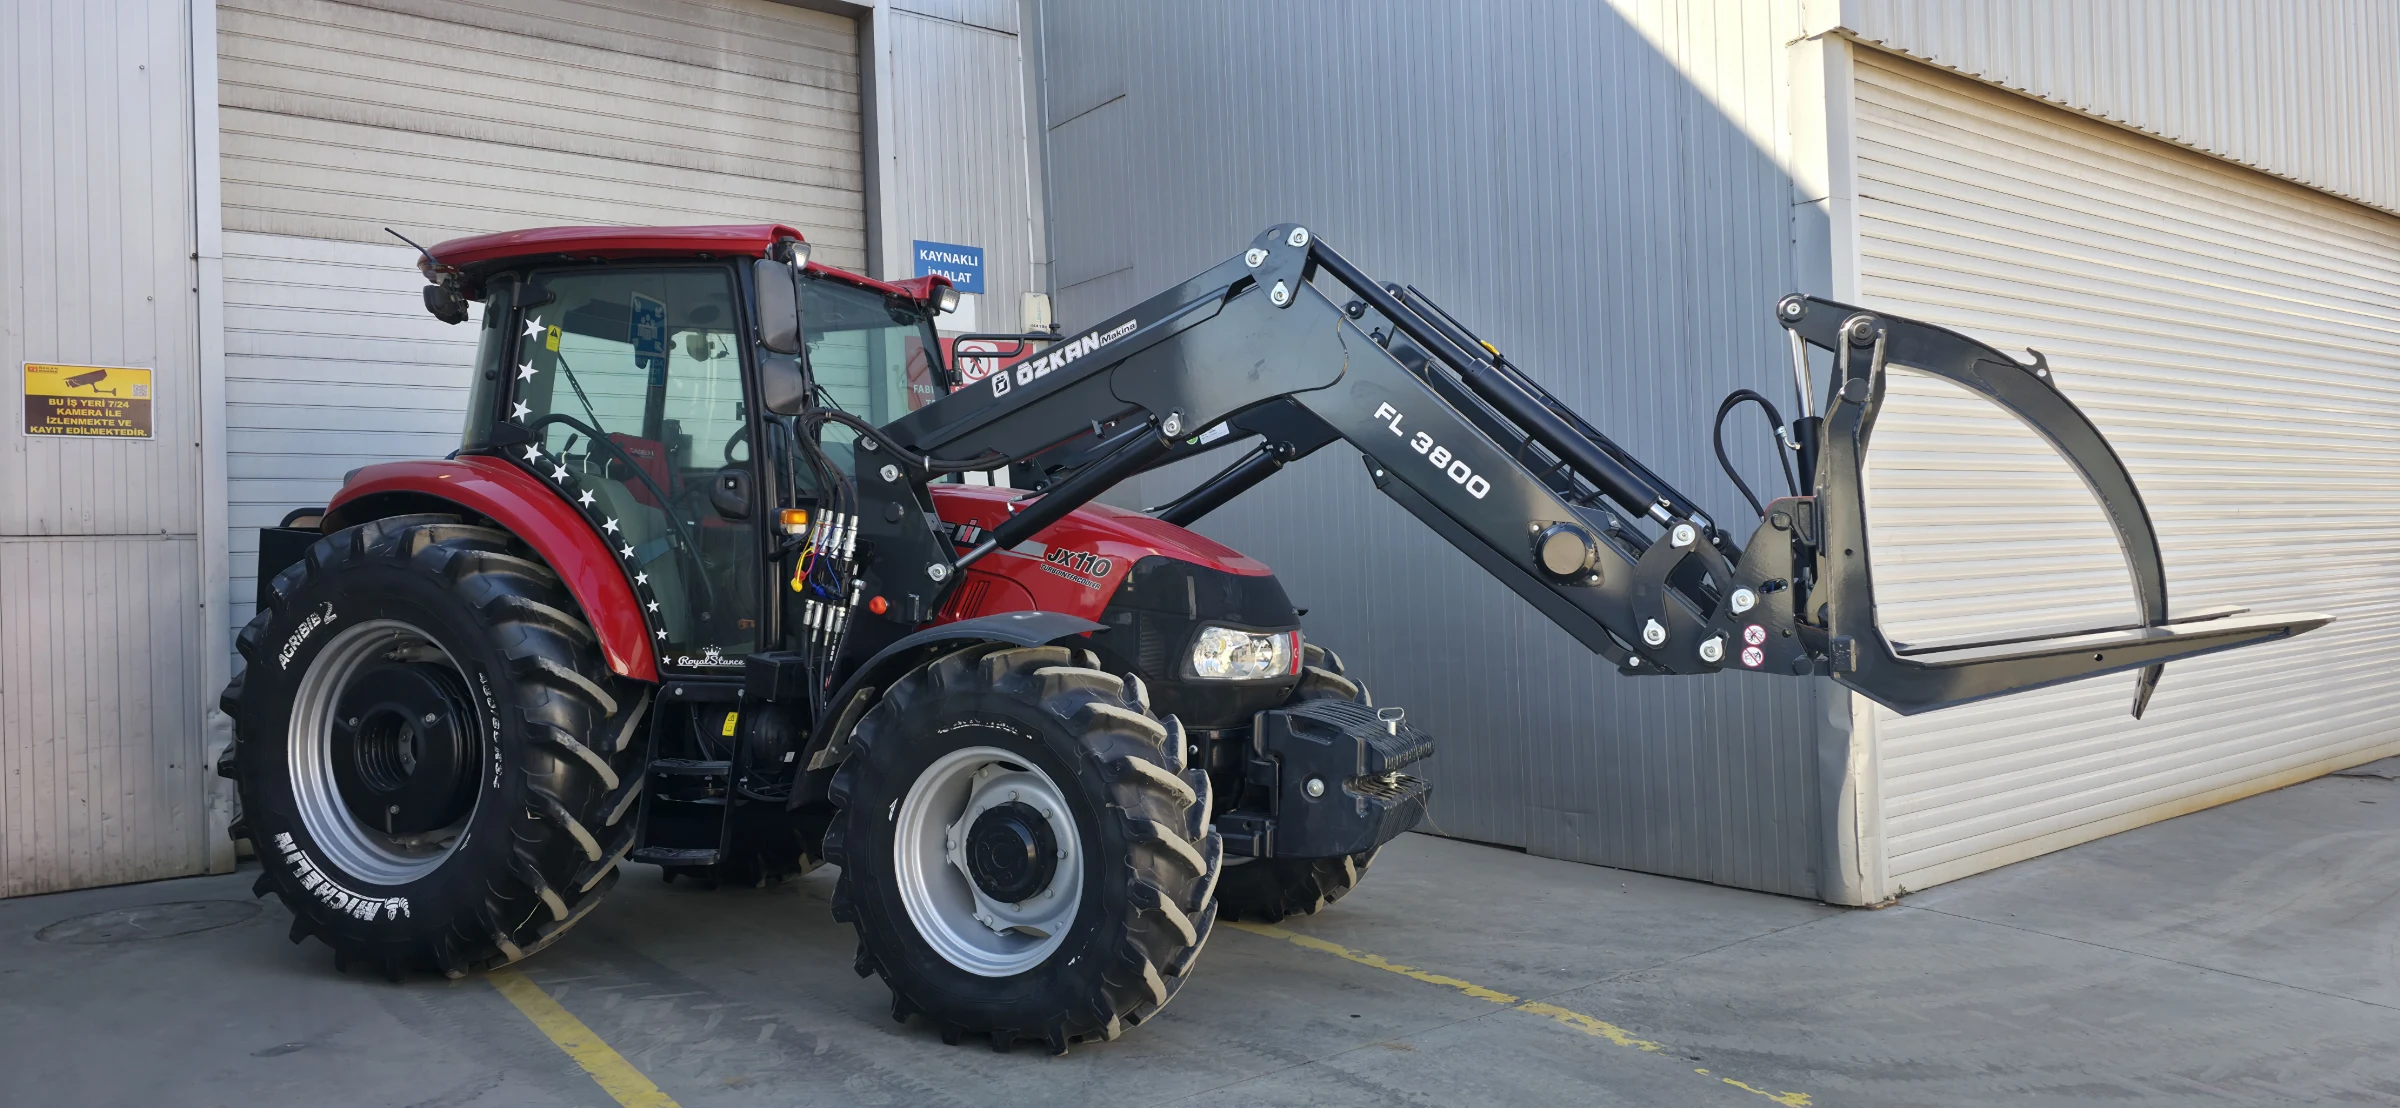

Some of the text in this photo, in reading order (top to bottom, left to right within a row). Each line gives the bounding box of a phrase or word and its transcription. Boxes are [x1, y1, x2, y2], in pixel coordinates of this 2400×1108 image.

[919, 249, 978, 267] KAYNAKLI
[1016, 331, 1100, 387] ÖZKAN
[1101, 321, 1137, 346] Makina
[48, 397, 130, 409] BU İŞ YERİ 7/24
[56, 407, 122, 418] KAMERA İLE
[30, 425, 148, 437] KAYIT EDİLMEKTEDİR.
[46, 415, 132, 427] İZLENMEKTE VE
[1373, 401, 1491, 500] FL 3800
[1046, 547, 1112, 578] JX110
[319, 600, 338, 625] 2
[274, 831, 382, 922] MICHELIN
